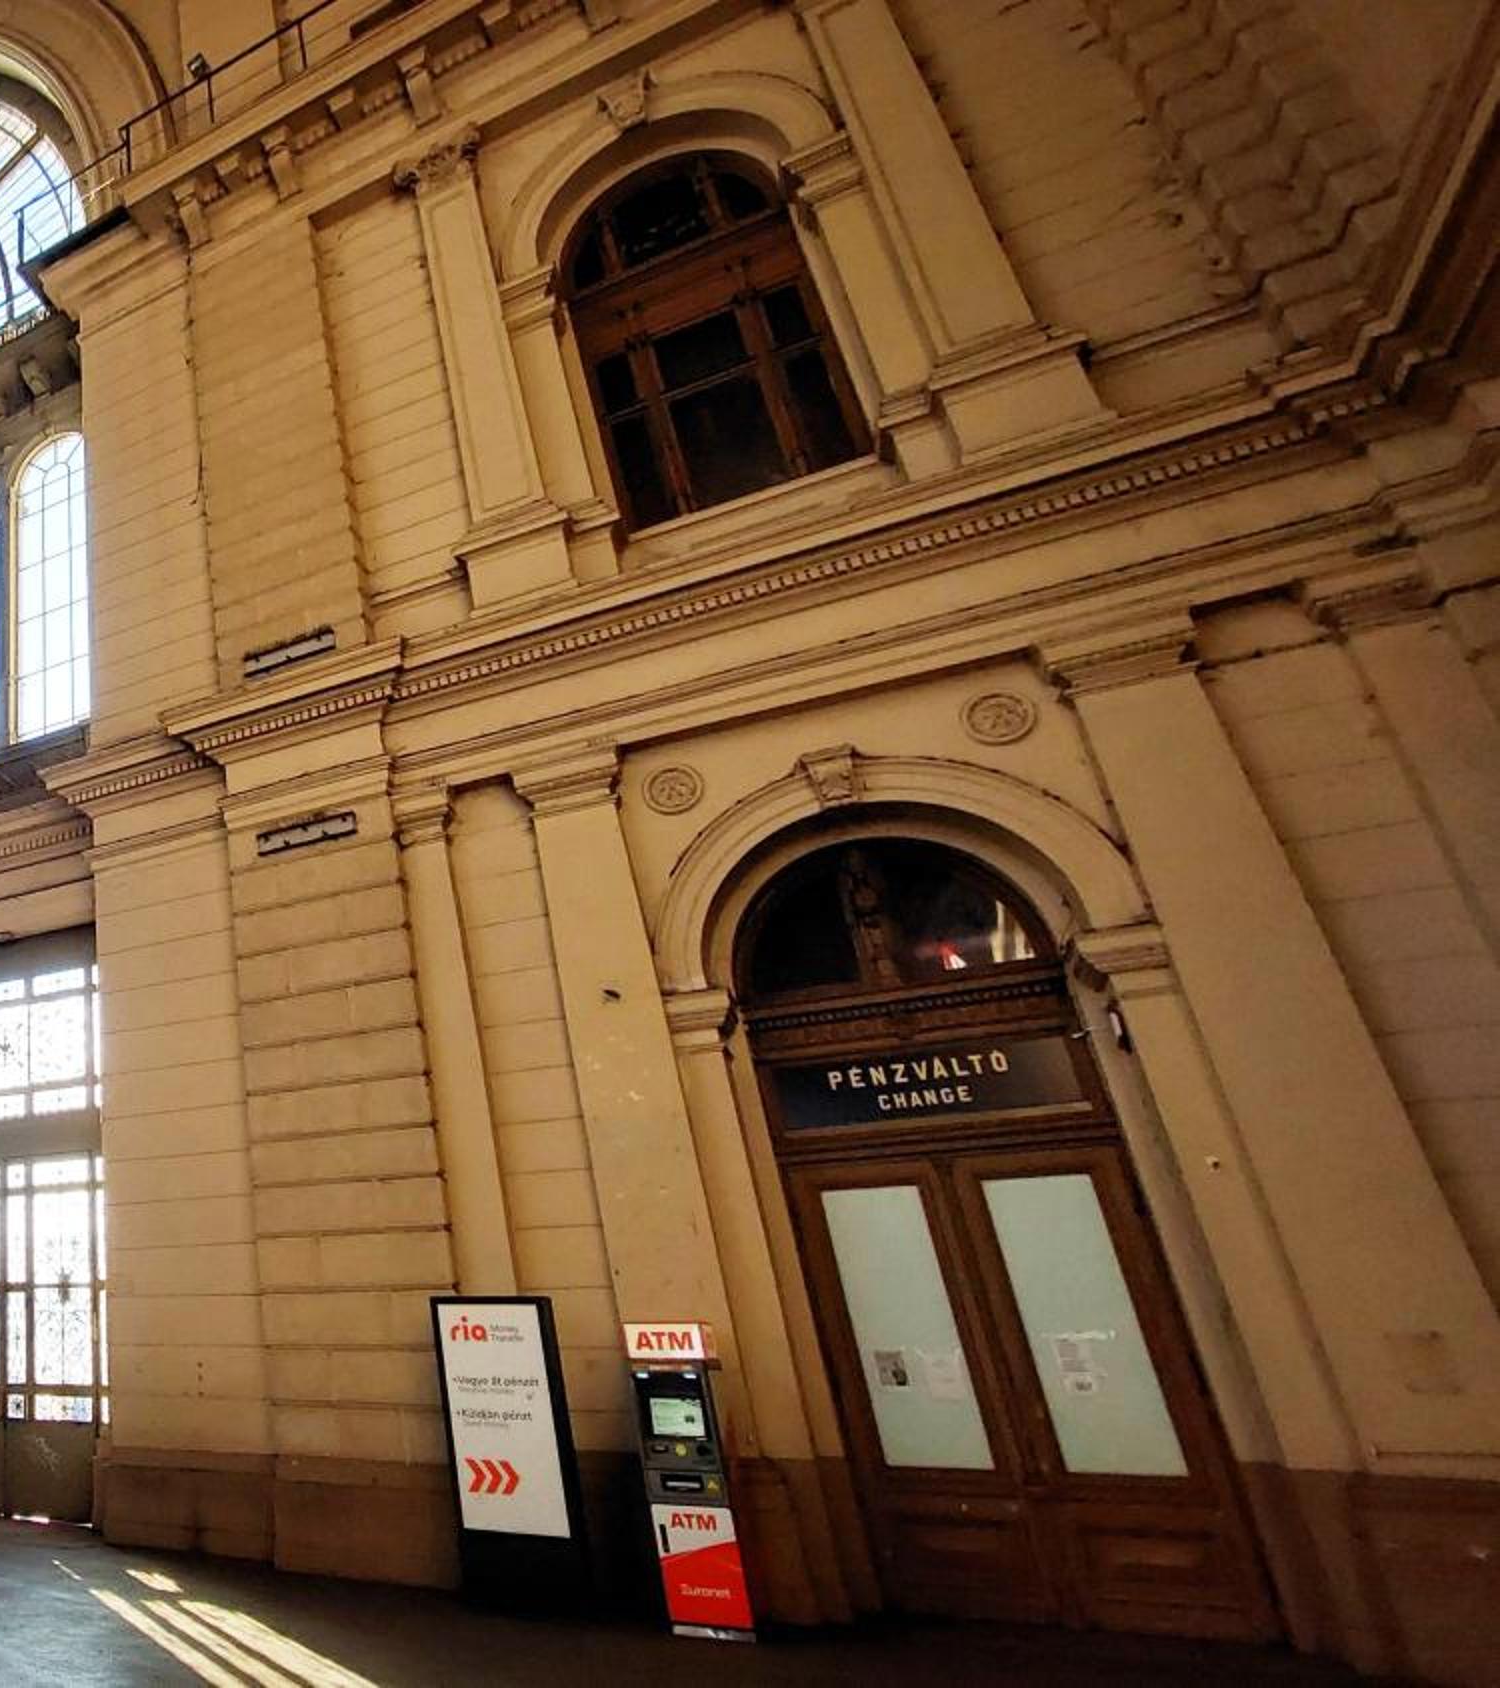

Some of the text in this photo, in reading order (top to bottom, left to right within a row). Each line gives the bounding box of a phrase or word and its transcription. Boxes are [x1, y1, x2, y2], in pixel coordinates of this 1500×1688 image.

[877, 1085, 973, 1111] CHANGE
[450, 1316, 488, 1342] ria
[636, 1331, 695, 1351] ATM
[670, 1513, 717, 1531] ATM
